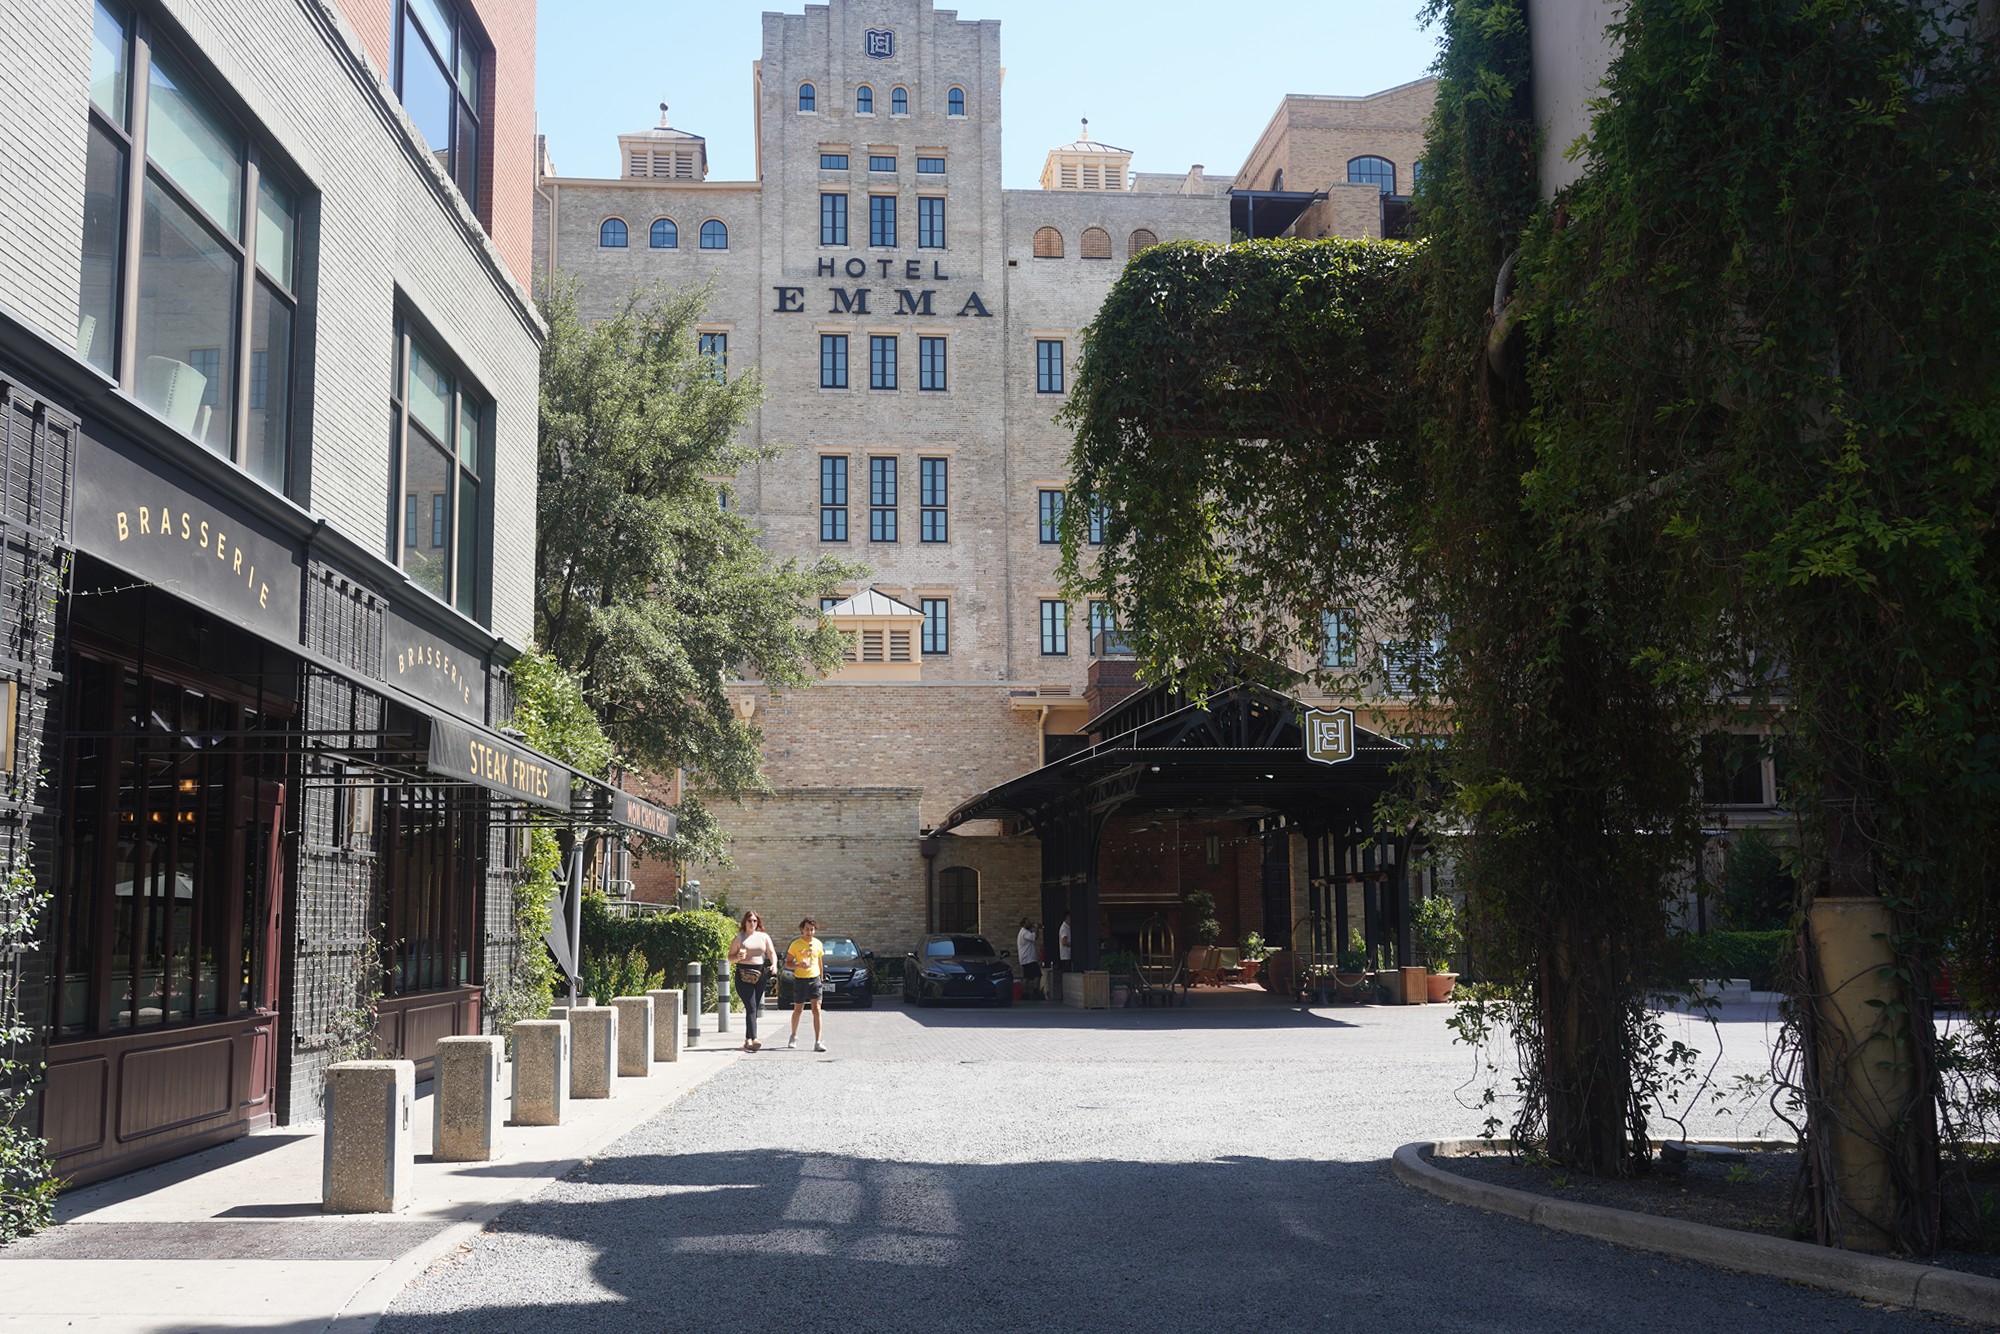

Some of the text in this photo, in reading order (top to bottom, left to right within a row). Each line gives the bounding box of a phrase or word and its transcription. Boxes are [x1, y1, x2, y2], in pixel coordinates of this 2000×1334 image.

[817, 257, 949, 281] HOTEL
[773, 286, 993, 318] EMMA
[117, 506, 269, 609] BRASSERIE
[399, 646, 469, 704] BRASSERIE
[470, 740, 548, 798] STEAK FRITES
[627, 800, 669, 836] MON CHOU CHOU
